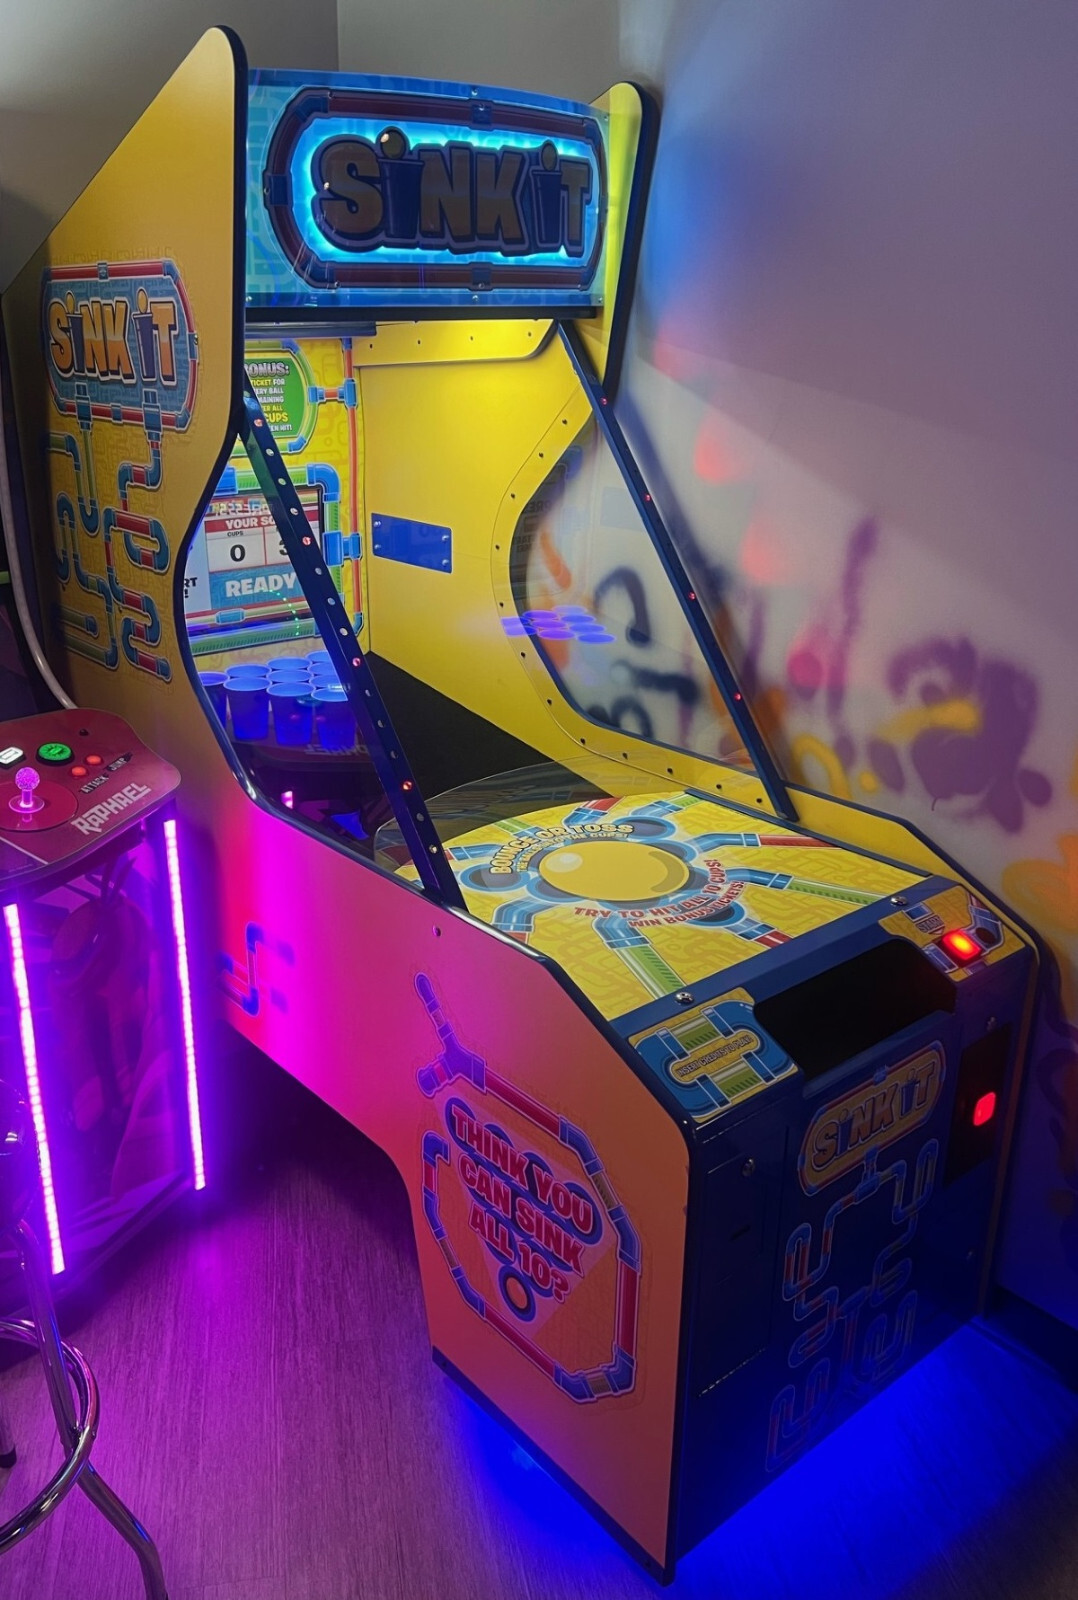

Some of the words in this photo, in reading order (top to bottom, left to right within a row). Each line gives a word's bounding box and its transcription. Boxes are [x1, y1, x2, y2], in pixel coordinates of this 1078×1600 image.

[225, 517, 259, 530] YOUR
[227, 530, 244, 538] CUPS
[230, 544, 246, 562] 0
[226, 573, 298, 597] READY
[80, 773, 110, 794] ATTACK
[490, 835, 541, 874] BOUNCE
[535, 826, 567, 839] OR
[569, 823, 634, 834] TOSS
[574, 906, 612, 918] TRY
[618, 909, 645, 918] TO
[650, 904, 681, 917] HIT
[684, 895, 712, 910] ALL
[704, 859, 726, 884] CUPS!
[628, 919, 660, 928] WIN
[665, 906, 716, 925] BONUS
[713, 881, 745, 909] TICKETS!
[675, 1060, 701, 1077] INSERT
[699, 1045, 728, 1067] CREDITS
[451, 1104, 530, 1190] THINK
[532, 1163, 594, 1235] YOU
[458, 1153, 512, 1219] CAN
[515, 1197, 585, 1278] SINK
[468, 1202, 515, 1262] ALL
[518, 1242, 571, 1304] 10?
